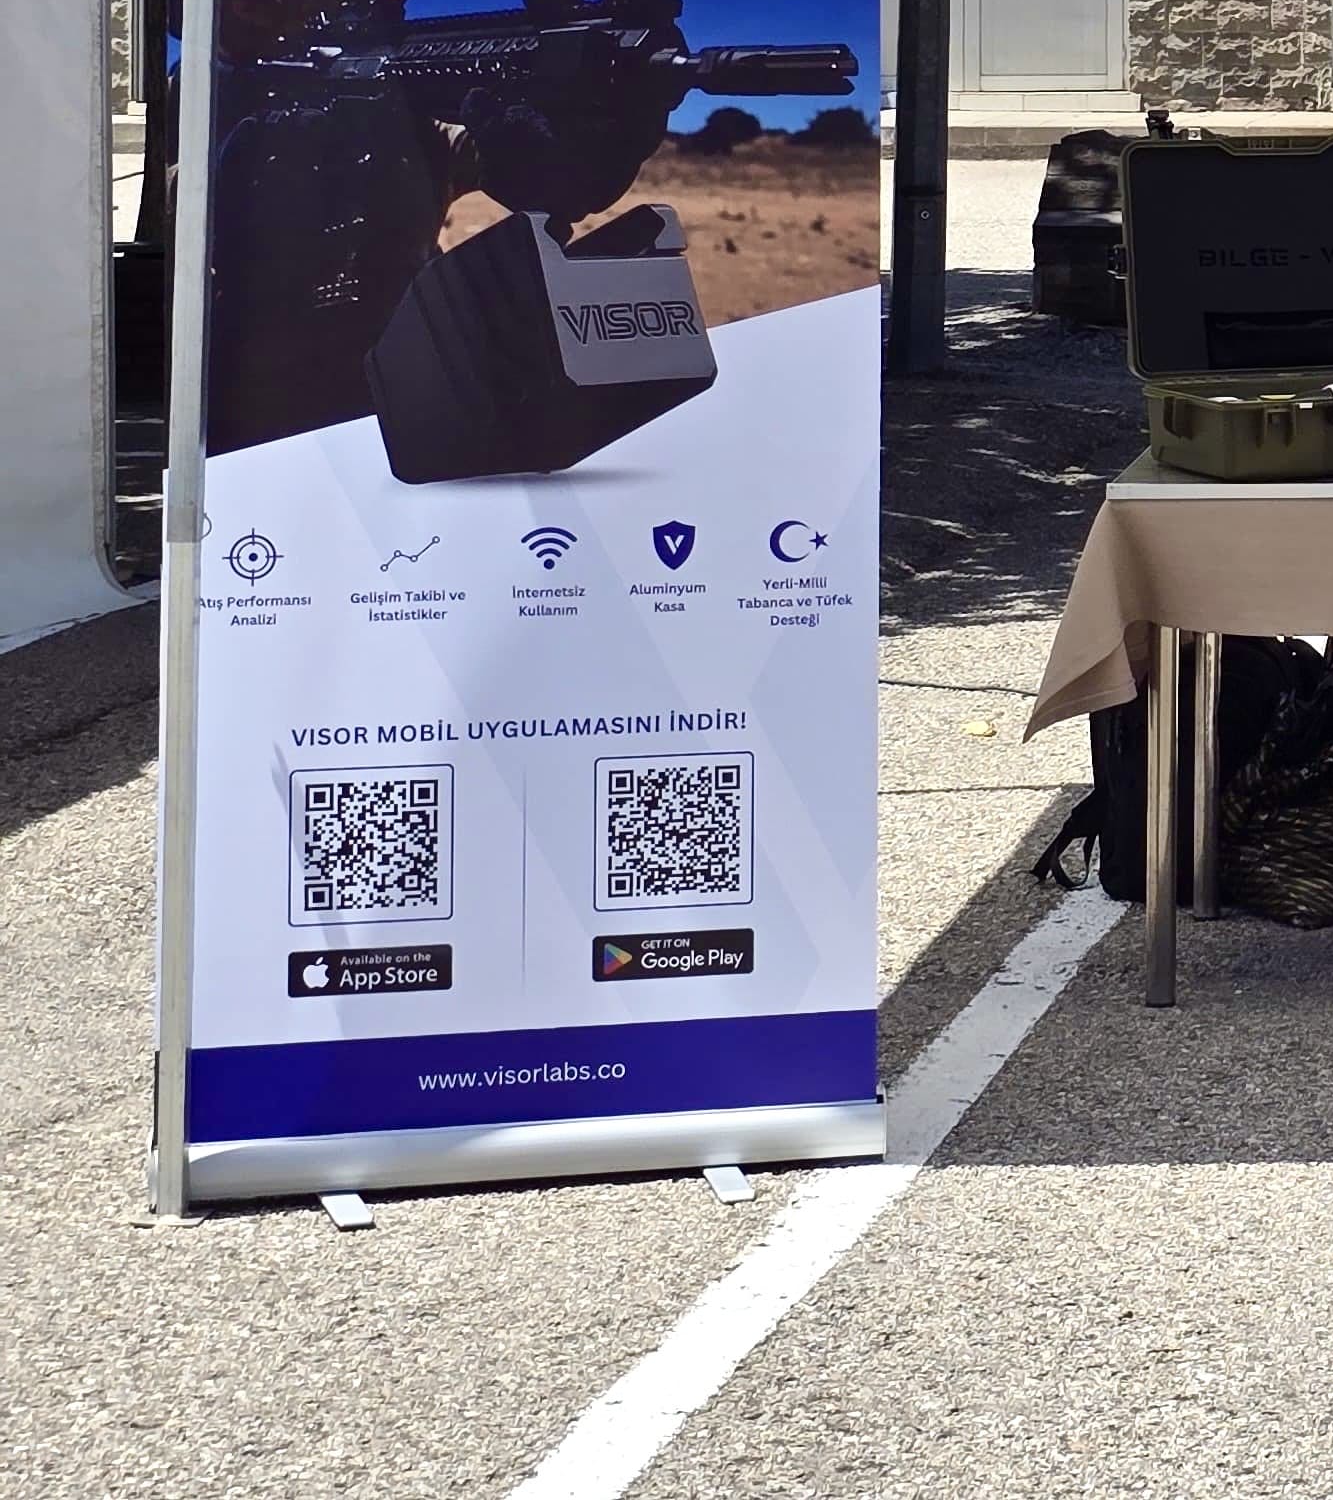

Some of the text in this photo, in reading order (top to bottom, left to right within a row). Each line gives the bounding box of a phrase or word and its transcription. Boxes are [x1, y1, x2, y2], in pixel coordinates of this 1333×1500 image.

[1198, 247, 1288, 267] BILGE
[558, 299, 701, 345] VISOR
[629, 582, 706, 596] Aluminyum
[762, 577, 827, 590] Yerli-Milli
[350, 591, 466, 605] Gelişim Takibi ve
[512, 585, 585, 598] İnternetsiz
[227, 596, 311, 608] Performansı
[654, 601, 685, 612] Kasa
[738, 594, 852, 609] Tabanca ve Tüfek
[368, 609, 447, 622] İstatistikler
[519, 604, 578, 617] Kullanım
[231, 615, 276, 625] Analizi
[770, 614, 820, 628] Desteği
[292, 709, 747, 747] VISOR MOBİL UYGULAMASINI İNDİR!
[642, 940, 660, 950] GET
[675, 938, 690, 948] ON
[341, 951, 431, 965] Available on the
[641, 949, 743, 972] Google Play
[340, 964, 438, 990] App Store
[419, 1060, 626, 1092] www.visorlabs.co
